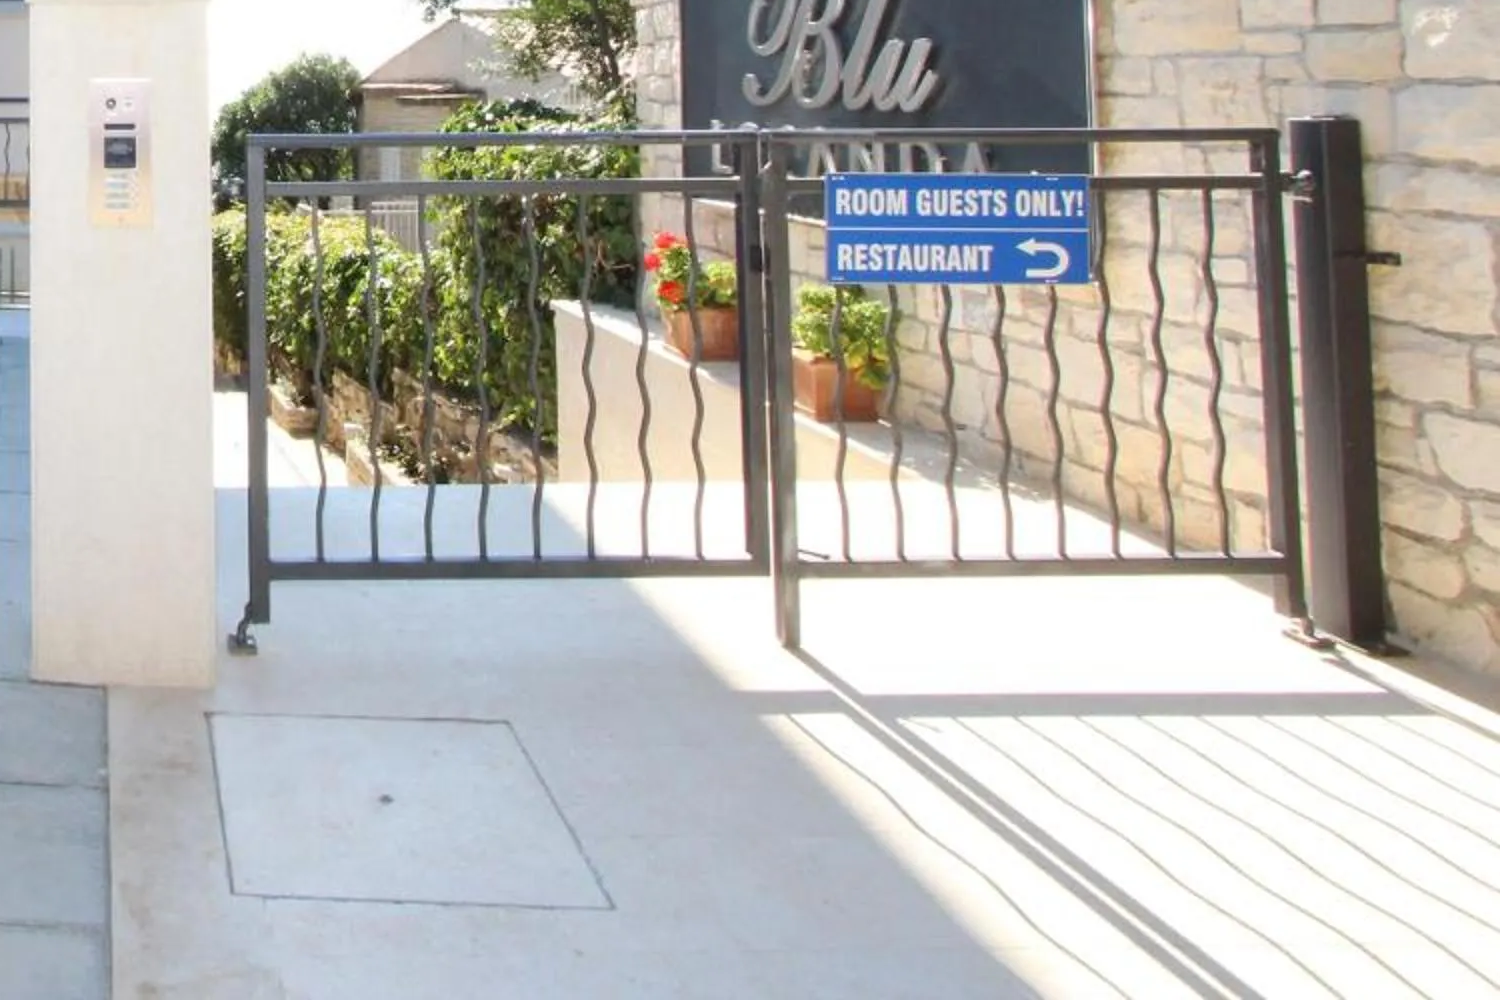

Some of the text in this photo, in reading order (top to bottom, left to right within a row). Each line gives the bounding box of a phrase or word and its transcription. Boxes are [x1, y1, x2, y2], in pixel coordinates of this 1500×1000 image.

[709, 119, 992, 175] LANDA
[835, 188, 1085, 217] ROOM GUESTS ONLY!
[837, 243, 994, 272] RESTAURANT
